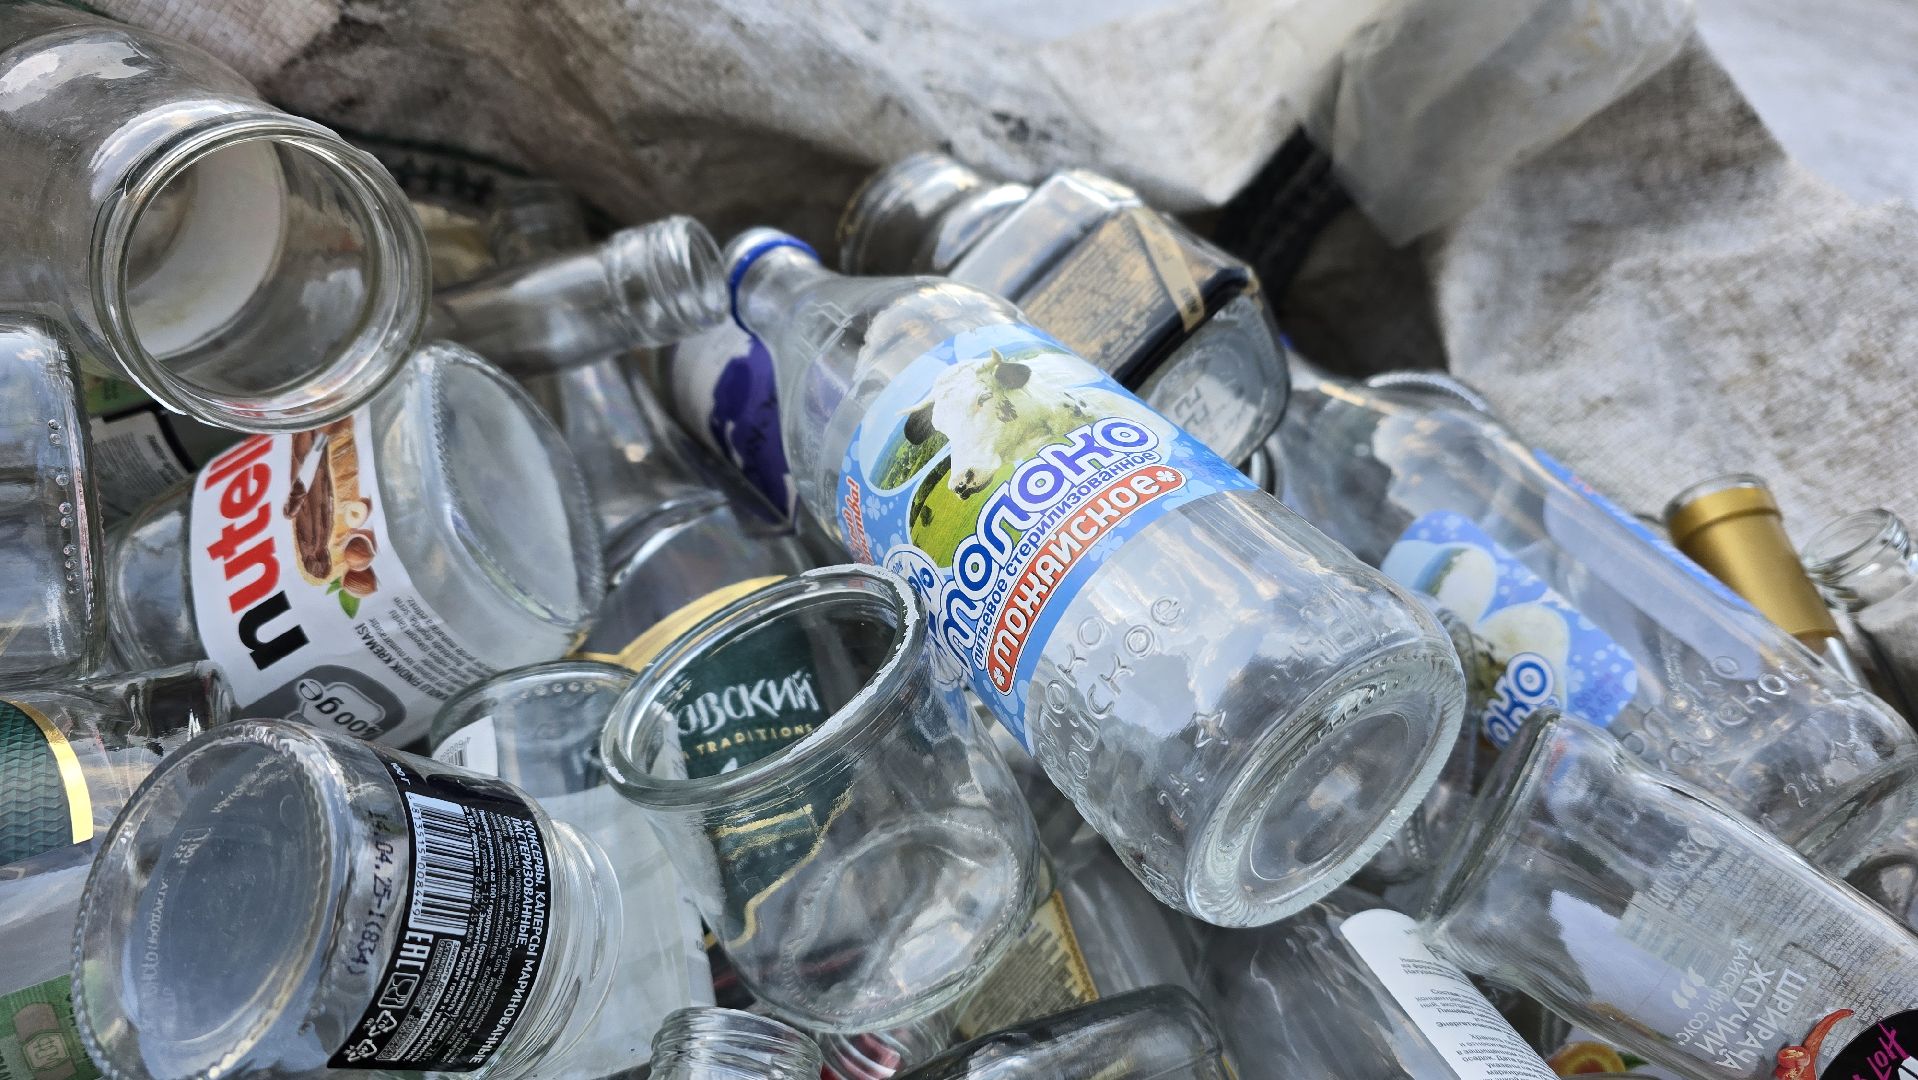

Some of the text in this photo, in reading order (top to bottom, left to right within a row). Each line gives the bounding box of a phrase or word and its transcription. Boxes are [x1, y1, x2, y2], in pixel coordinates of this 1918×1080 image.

[974, 577, 1008, 668] питьевое
[1005, 450, 1158, 581] стерилизованное
[354, 623, 395, 664] KREMASI
[696, 723, 813, 755] TRADITIONS
[411, 862, 427, 917] 008449
[511, 816, 535, 949] ПАСТЕРИЗОВАННЫЕ.
[453, 946, 471, 981] Продукт
[469, 820, 546, 1064] КОНСЕРВЫ. КАПЕРСЫ МАРИНОВАННЫЕ
[1694, 959, 1777, 1058] ЖГУЧИЙ
[1715, 968, 1807, 1071] ШРИРАЧА
